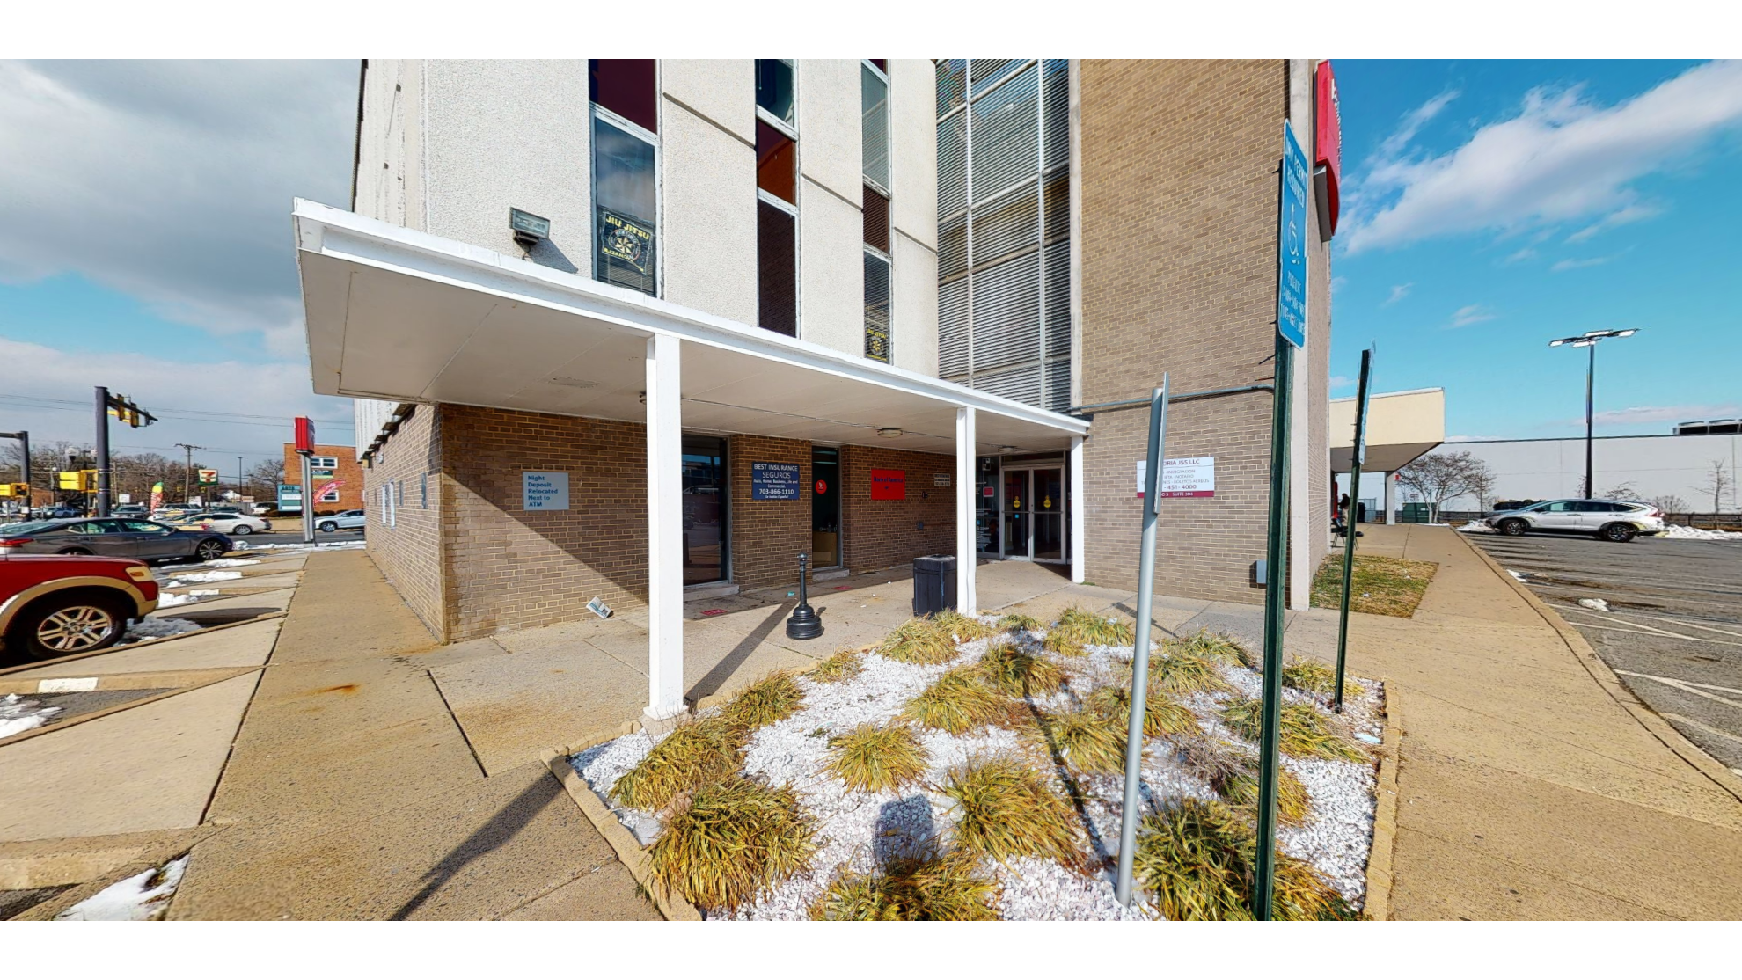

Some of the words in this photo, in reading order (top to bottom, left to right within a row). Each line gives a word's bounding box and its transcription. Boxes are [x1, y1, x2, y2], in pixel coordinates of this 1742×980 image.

[606, 216, 622, 227] JIU
[624, 223, 649, 239] JITSU
[769, 464, 798, 472] INSURANCE
